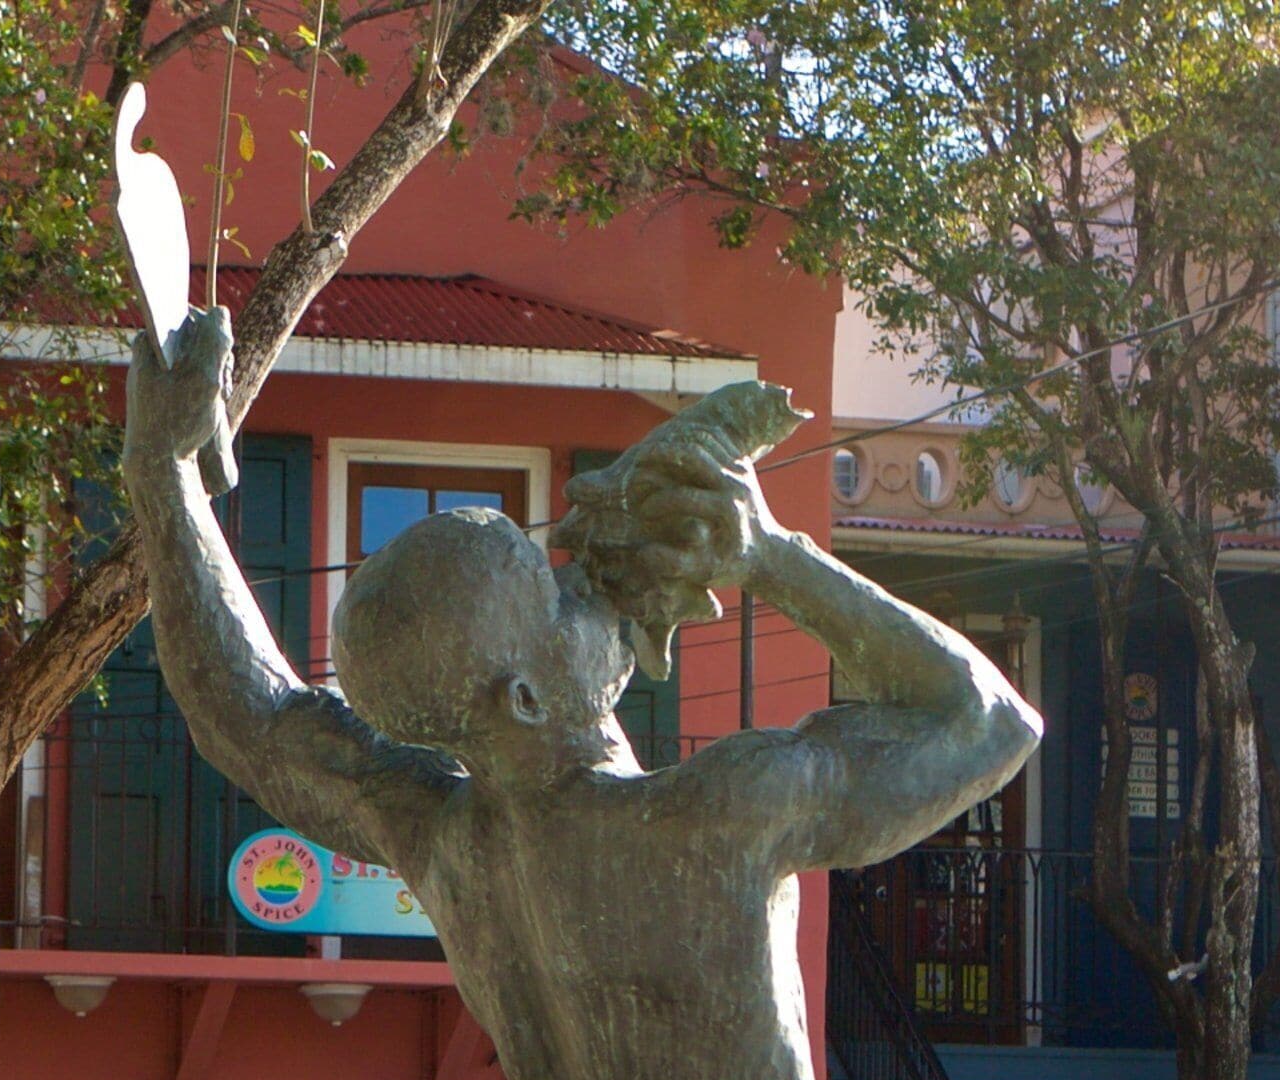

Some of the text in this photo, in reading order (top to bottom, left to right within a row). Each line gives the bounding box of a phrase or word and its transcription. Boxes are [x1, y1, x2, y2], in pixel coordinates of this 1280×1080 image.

[242, 839, 315, 870] ST. JOHN
[252, 901, 305, 920] SPICE
